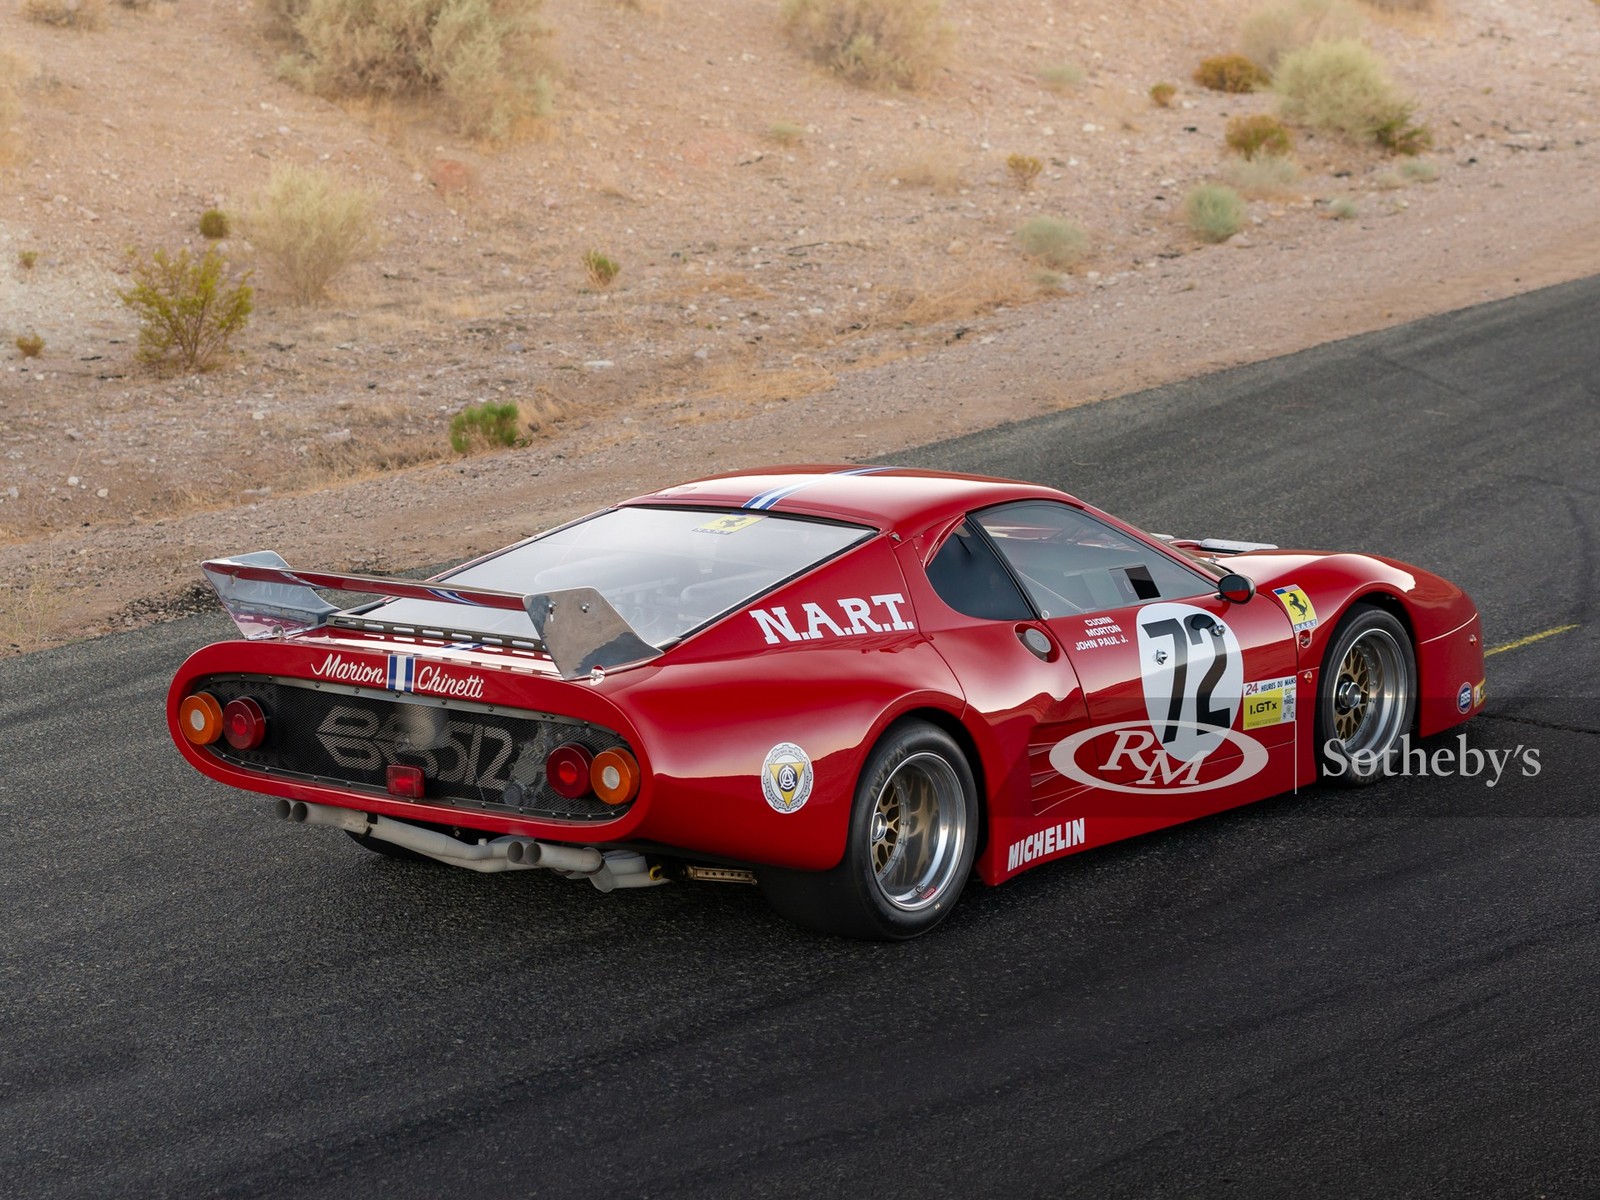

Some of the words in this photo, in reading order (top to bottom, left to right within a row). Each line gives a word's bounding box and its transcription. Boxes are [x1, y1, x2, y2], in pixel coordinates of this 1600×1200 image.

[748, 593, 915, 645] N.A.R.T.
[1084, 616, 1114, 627] CUDINI
[1085, 624, 1122, 637] MORTON
[1075, 639, 1098, 651] JOHN
[1097, 636, 1121, 647] PAUL
[1120, 634, 1129, 643] J.
[311, 653, 384, 684] Marion
[417, 666, 484, 698] Chinetti
[1140, 614, 1232, 745] 72
[1245, 682, 1259, 696] 24
[1007, 817, 1085, 872] MICHELIN
